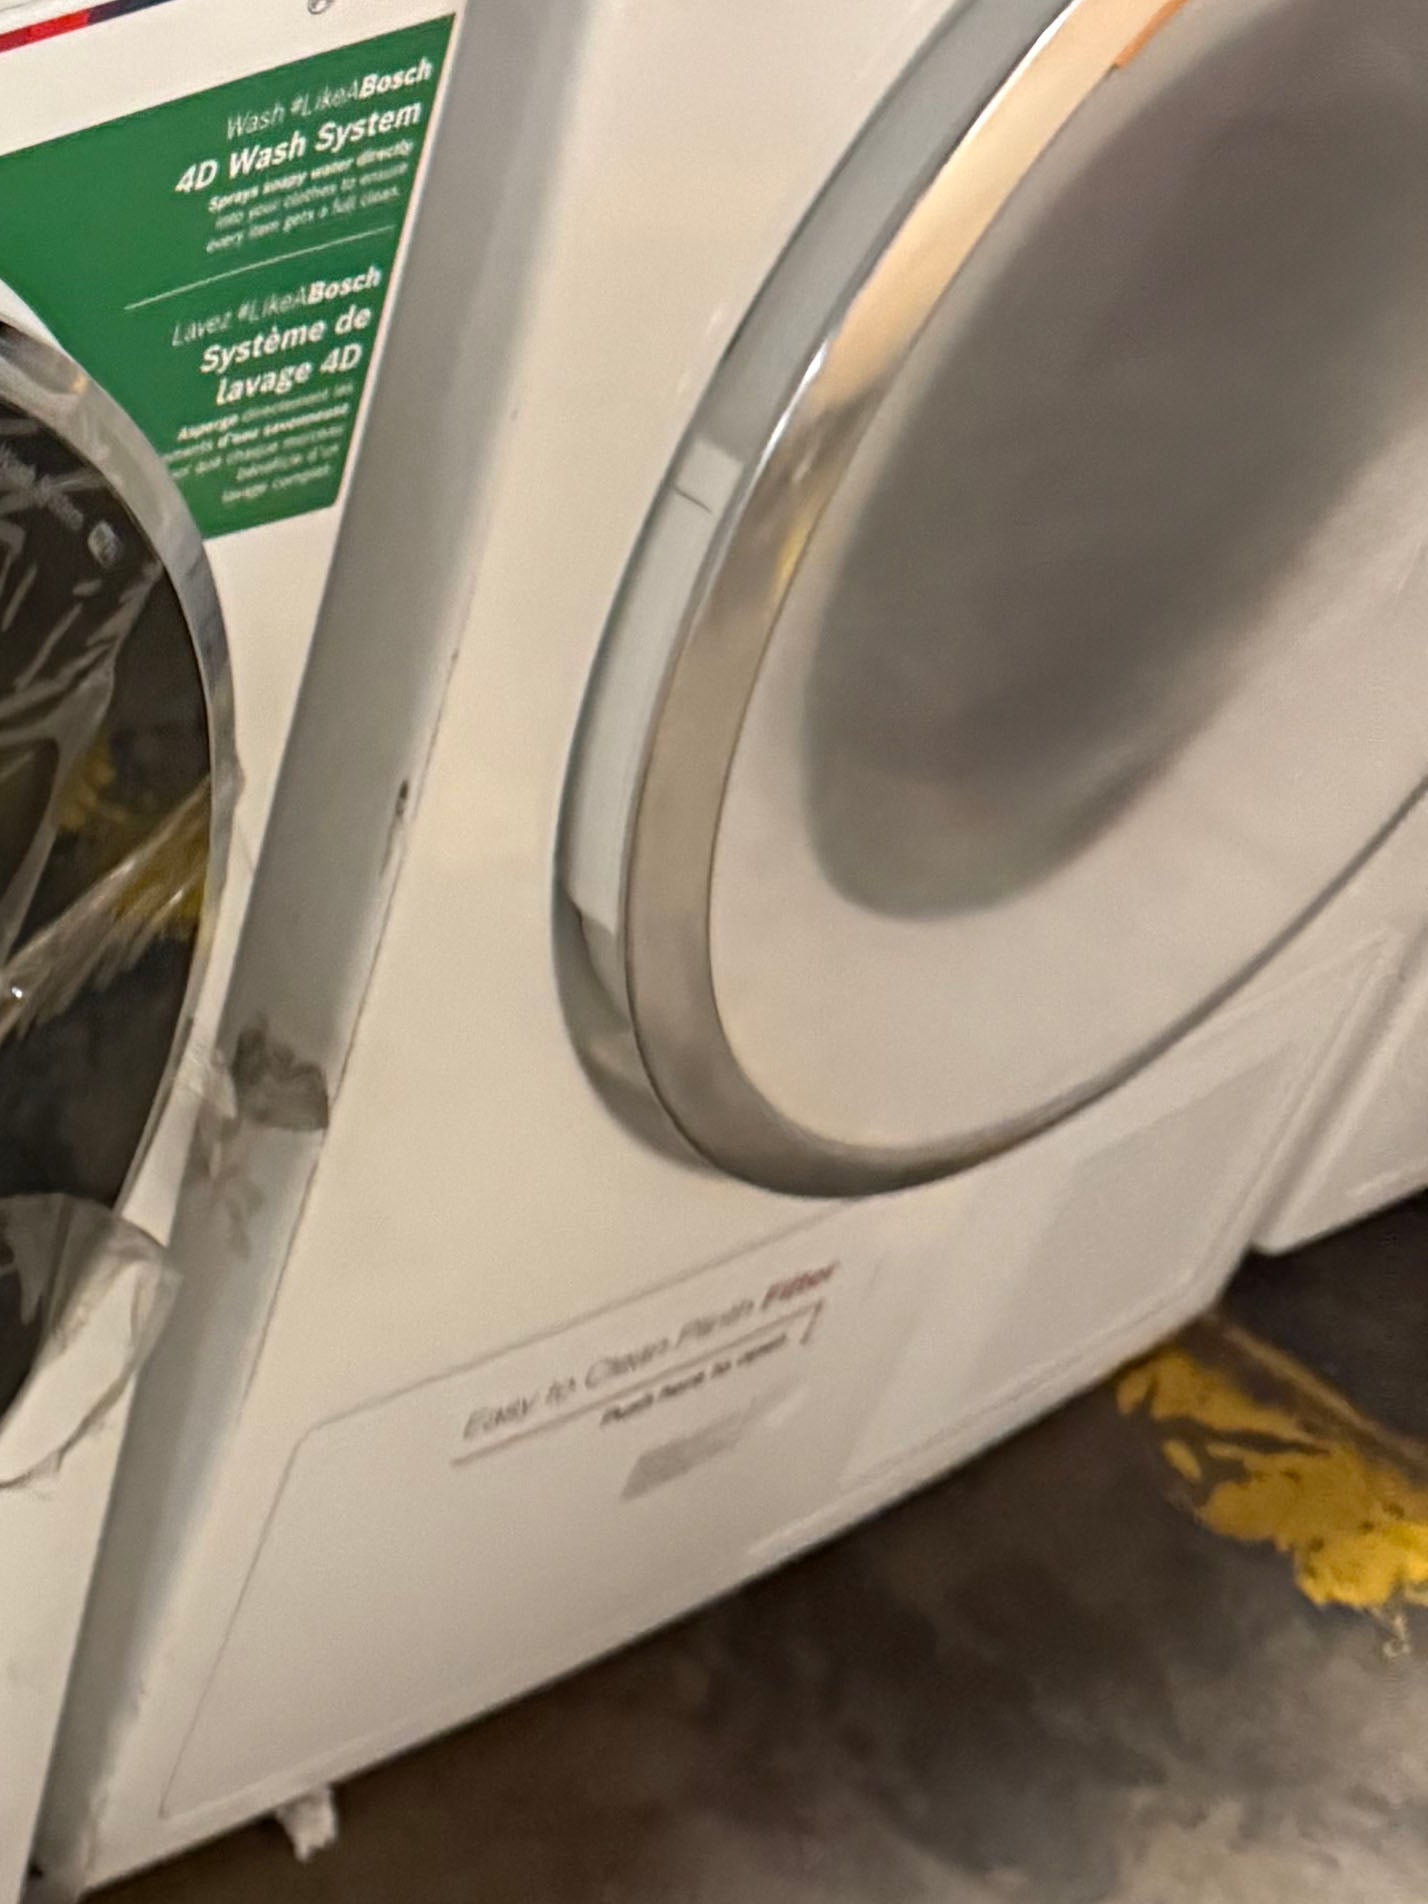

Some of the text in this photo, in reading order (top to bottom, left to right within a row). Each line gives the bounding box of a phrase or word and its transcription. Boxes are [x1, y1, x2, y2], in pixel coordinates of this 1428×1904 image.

[226, 56, 433, 140] Wash #LikeABosch
[175, 101, 422, 193] 4D Wash System
[208, 186, 259, 213] Sprays
[310, 158, 355, 179] water
[172, 264, 382, 346] Lavez #LikeABosch
[199, 304, 372, 374] Système de
[216, 342, 363, 406] lavage 4D
[464, 1393, 540, 1440] Easy
